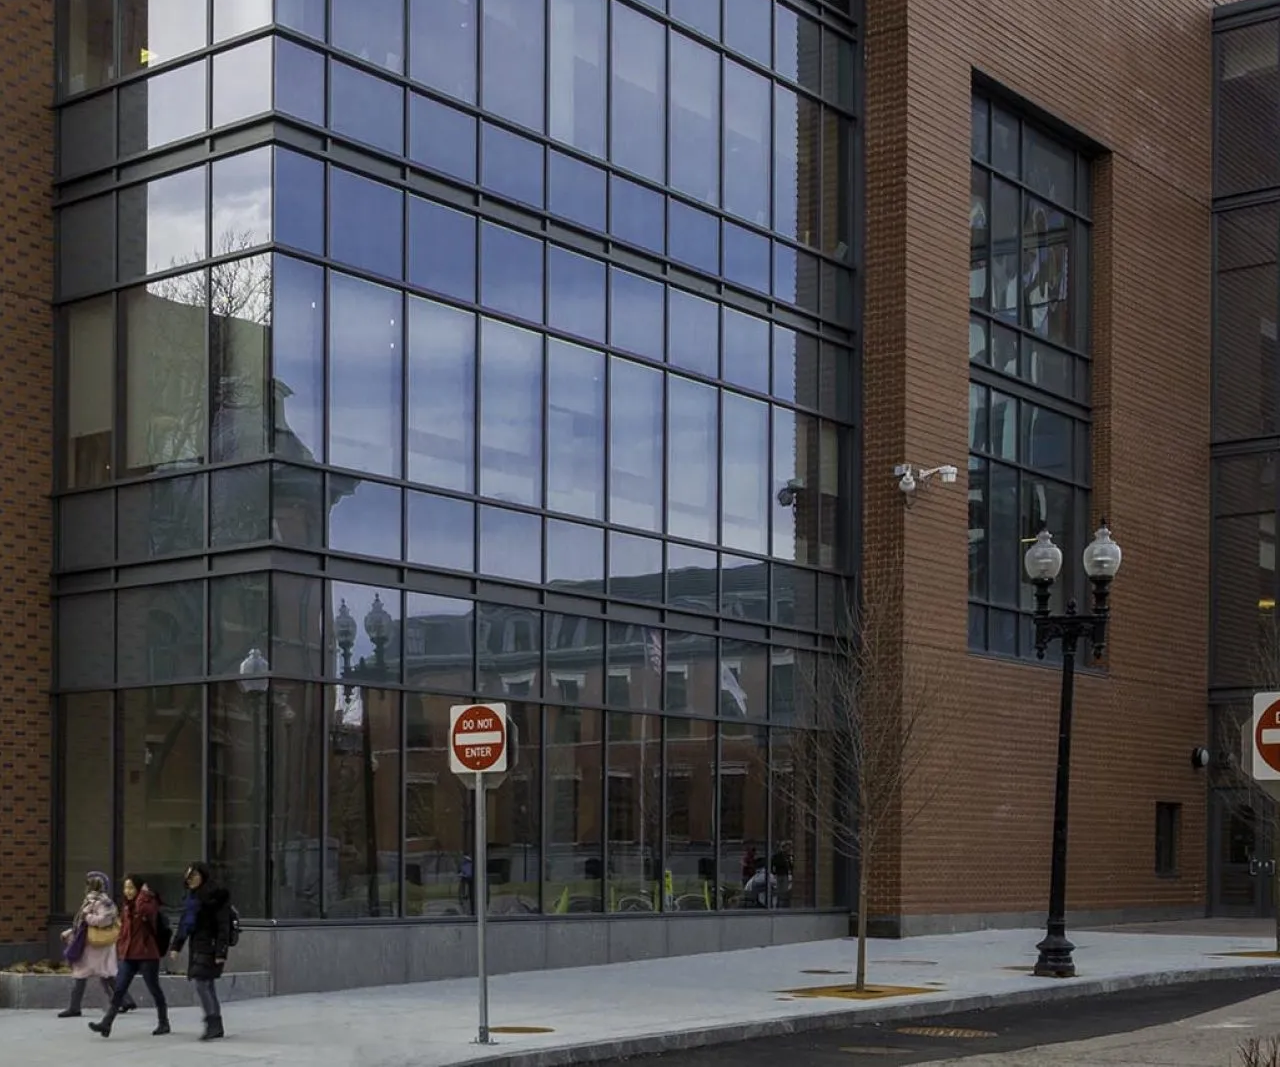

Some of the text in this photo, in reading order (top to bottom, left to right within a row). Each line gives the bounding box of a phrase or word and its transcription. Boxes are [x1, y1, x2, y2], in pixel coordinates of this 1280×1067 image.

[463, 718, 493, 730] DO NOT
[465, 747, 492, 758] ENTER
